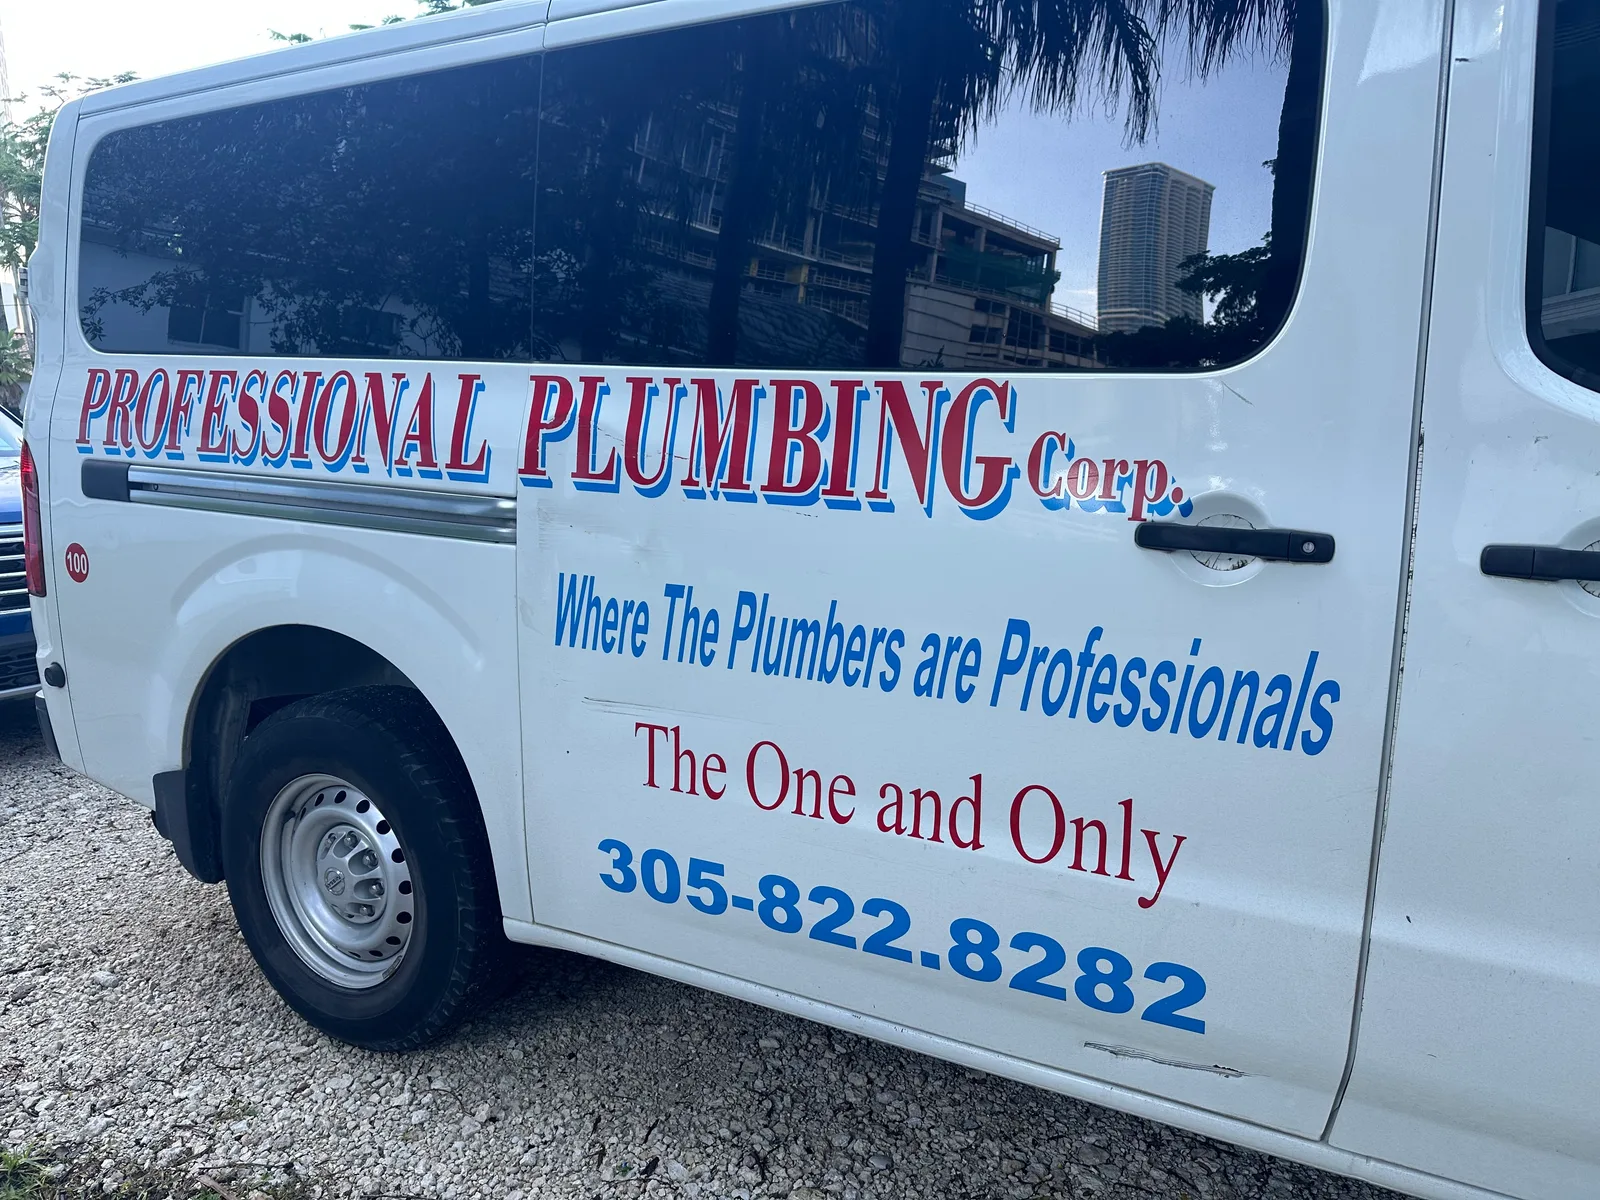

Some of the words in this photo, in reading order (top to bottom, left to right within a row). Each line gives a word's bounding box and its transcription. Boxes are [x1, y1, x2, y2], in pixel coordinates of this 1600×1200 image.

[76, 368, 492, 484] PROFESSIONAL
[517, 374, 1021, 520] PLUMBING
[1028, 431, 1191, 522] Corp.
[67, 551, 88, 574] 100
[554, 572, 650, 658] Where
[662, 583, 720, 668] The
[727, 590, 905, 693] Plumbers
[913, 632, 982, 704] are
[989, 618, 1341, 756] Professionals
[635, 722, 728, 801] The
[746, 740, 856, 825] One
[877, 774, 985, 851] and
[1009, 784, 1187, 909] Only
[597, 838, 1207, 1035] 305-822.8282
